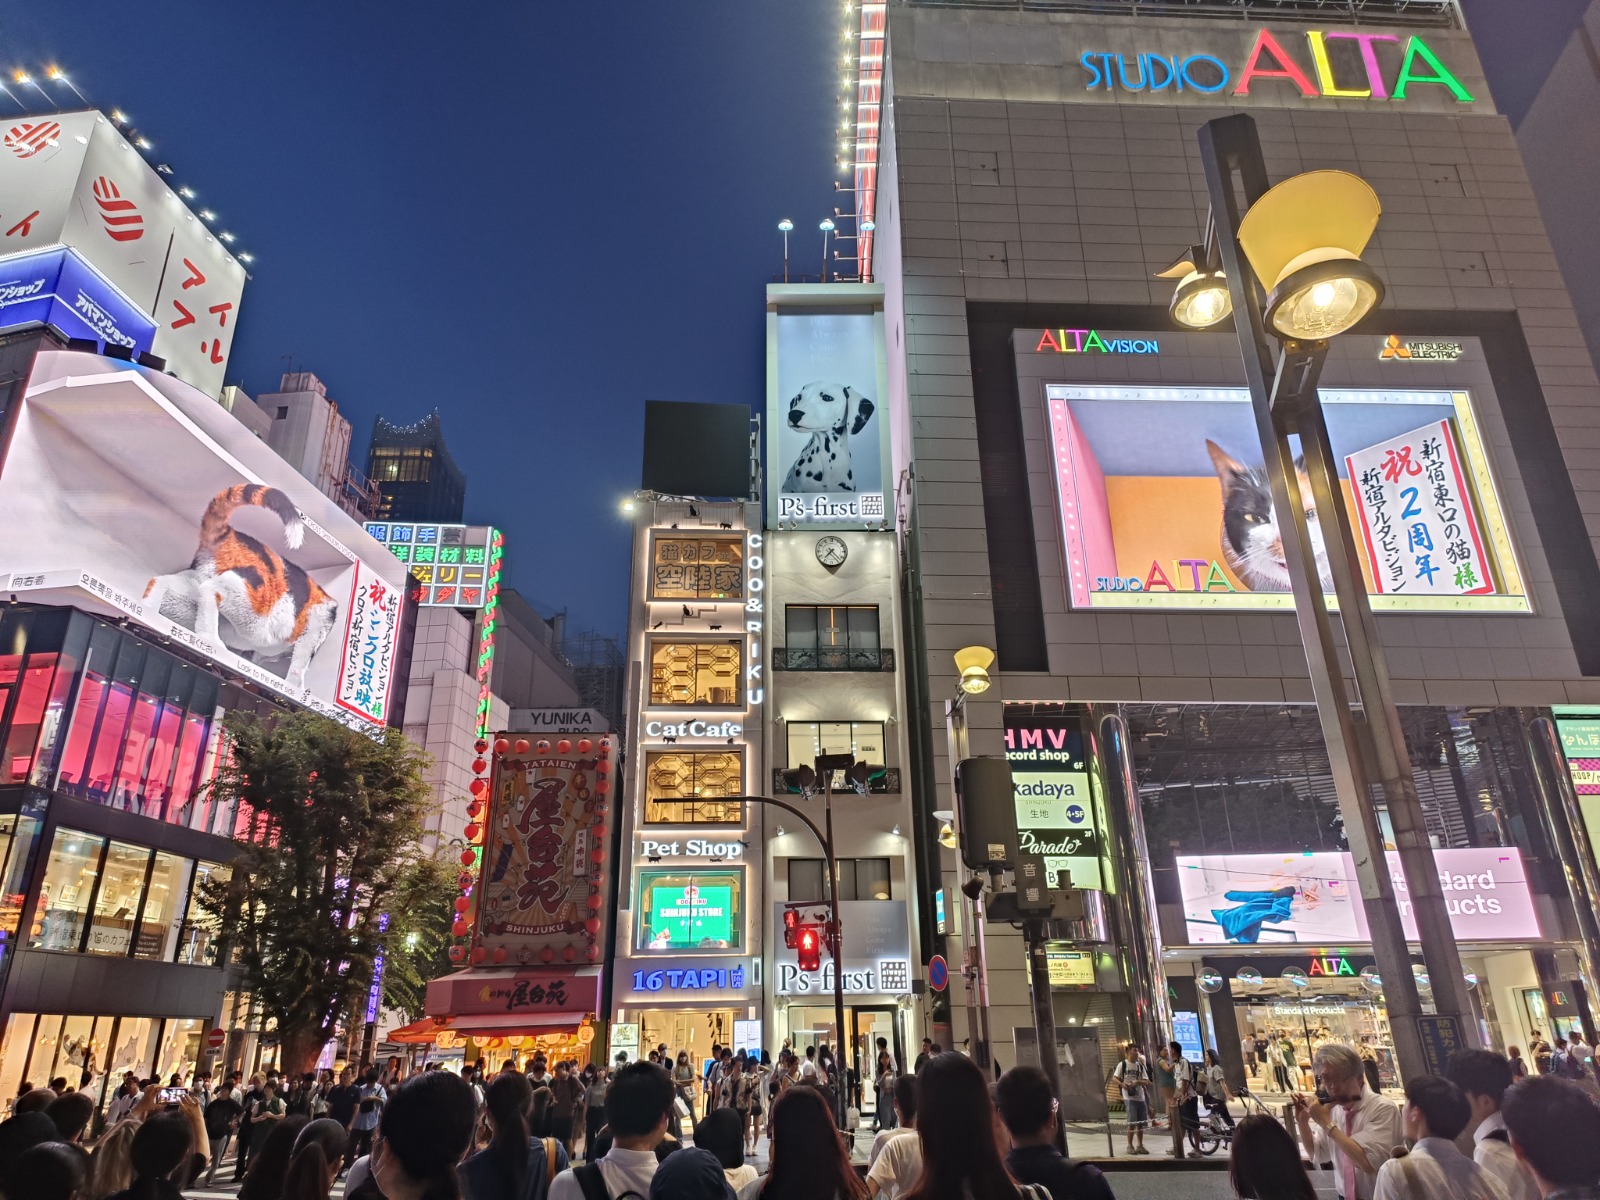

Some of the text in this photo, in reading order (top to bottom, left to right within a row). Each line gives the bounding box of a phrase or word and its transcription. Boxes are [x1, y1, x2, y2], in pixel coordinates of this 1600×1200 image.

[1080, 27, 1476, 103] STUDIO ALTA
[1408, 342, 1463, 351] MITSUBISHI
[1411, 350, 1458, 359] ELECTRIC
[1359, 467, 1407, 593] 新宿アルタビジョン
[391, 545, 484, 564] 洋装材料
[661, 543, 731, 561] 猫カフェ
[656, 563, 742, 591] 空陸家
[1096, 559, 1236, 592] STUDIO ALTA
[81, 573, 113, 599] 오른쪽을
[745, 533, 763, 705] COO&RIKU
[170, 626, 216, 655] 右をご覧ください
[344, 585, 367, 701] クロス新宿ビジョン
[237, 660, 295, 697] Look to the right side
[531, 712, 592, 725] YUNIKA
[646, 721, 742, 737] Cat Cafe
[1004, 729, 1067, 749] HMV
[523, 759, 577, 770] YATAIEN
[1040, 750, 1070, 763] shop
[1073, 762, 1084, 770] 6F
[1030, 809, 1050, 819] 生地
[641, 839, 741, 860] Pet Shop
[1018, 830, 1082, 855] Parade
[1023, 863, 1040, 902] 音響
[660, 907, 724, 918] SHINJUKU STORE
[506, 923, 564, 935] SHINJUKU
[1309, 958, 1355, 976] ALTA
[1552, 991, 1569, 1005] ALTA
[1310, 1006, 1346, 1015] Products
